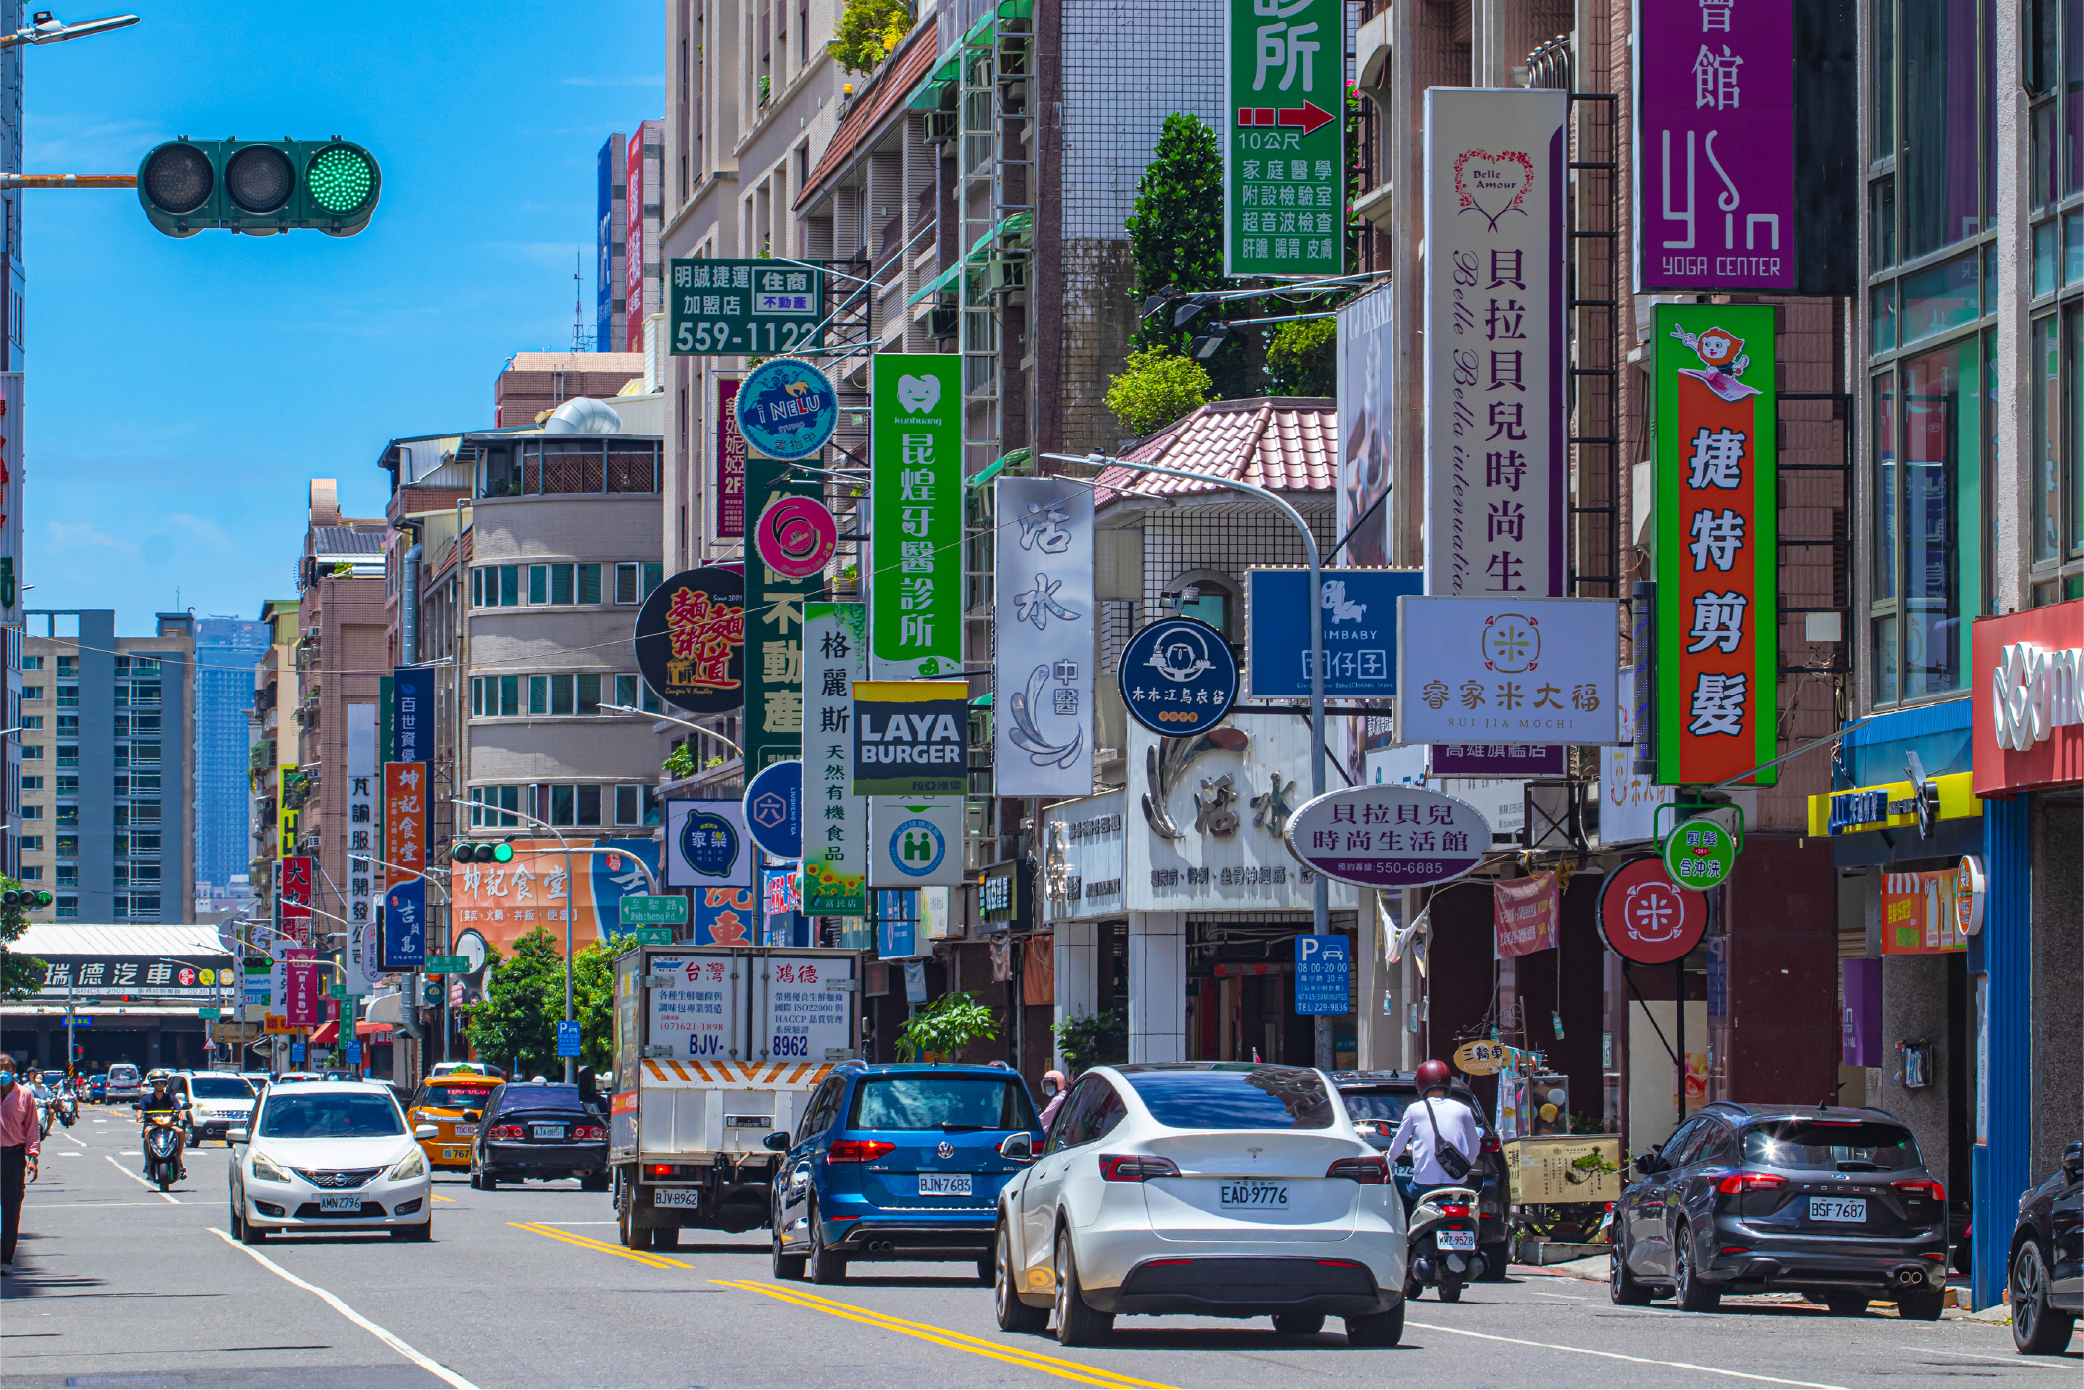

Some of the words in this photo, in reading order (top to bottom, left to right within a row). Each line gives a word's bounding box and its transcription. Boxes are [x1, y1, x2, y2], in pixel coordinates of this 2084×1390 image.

[1238, 132, 1301, 151] 10公尺
[1242, 160, 1333, 181] 家庭醫學
[1473, 169, 1501, 180] Belle
[1476, 179, 1517, 191] Amour
[1242, 185, 1333, 208] 附設檢驗室
[1242, 211, 1333, 234] 超音波檢查
[1242, 238, 1269, 260] 肝膽
[1274, 238, 1301, 260] 腸胃
[1306, 238, 1333, 260] 皮膚
[674, 265, 750, 288] 明誠捷運
[1663, 256, 1708, 275] YOGA
[1716, 257, 1780, 276] CENTER
[762, 271, 808, 291] 住商
[763, 295, 807, 309] 不動產
[1453, 249, 1480, 337] Belle
[683, 295, 741, 316] 加盟店
[676, 321, 818, 352] 559-1122
[1453, 347, 1480, 437] Bella
[770, 394, 820, 421] NELU
[894, 417, 942, 426] kunhuang
[1484, 248, 1529, 593] 貝拉貝兒時尚生
[899, 432, 937, 648] 昆煌牙醫診所
[1013, 502, 1082, 631] 活水
[1686, 426, 1748, 738] 捷特剪髮
[819, 630, 852, 734] 格麗斯
[1052, 657, 1080, 717] 中醫
[1420, 679, 1601, 713] 睿家米大福
[861, 713, 960, 742] LAYA
[1448, 717, 1476, 728] RUI
[1485, 717, 1510, 730] JIA
[1519, 718, 1574, 730] MOCHI
[860, 743, 961, 765] BURGER
[911, 780, 962, 791] 拉亞漢堡
[759, 798, 781, 820] 六
[823, 744, 846, 862] 天然有機食品
[397, 769, 421, 862] 坤記食堂
[1329, 803, 1456, 826] 貝拉貝兒
[1312, 830, 1469, 852] 時尚生活館
[1686, 830, 1718, 847] 剪髮
[1376, 861, 1443, 875] 550-6885
[463, 863, 568, 901] 坤記食堂
[1302, 938, 1319, 961] P
[44, 962, 174, 986] 瑞德汽車
[685, 961, 725, 983] 台灣
[775, 963, 819, 984] 鴻德
[1298, 962, 1348, 973] 08:00-20:00
[775, 1014, 807, 1024] HACCP
[793, 1003, 833, 1013] ISO22000
[660, 1022, 724, 1031] (07)621-1898
[773, 1035, 808, 1057] 8962
